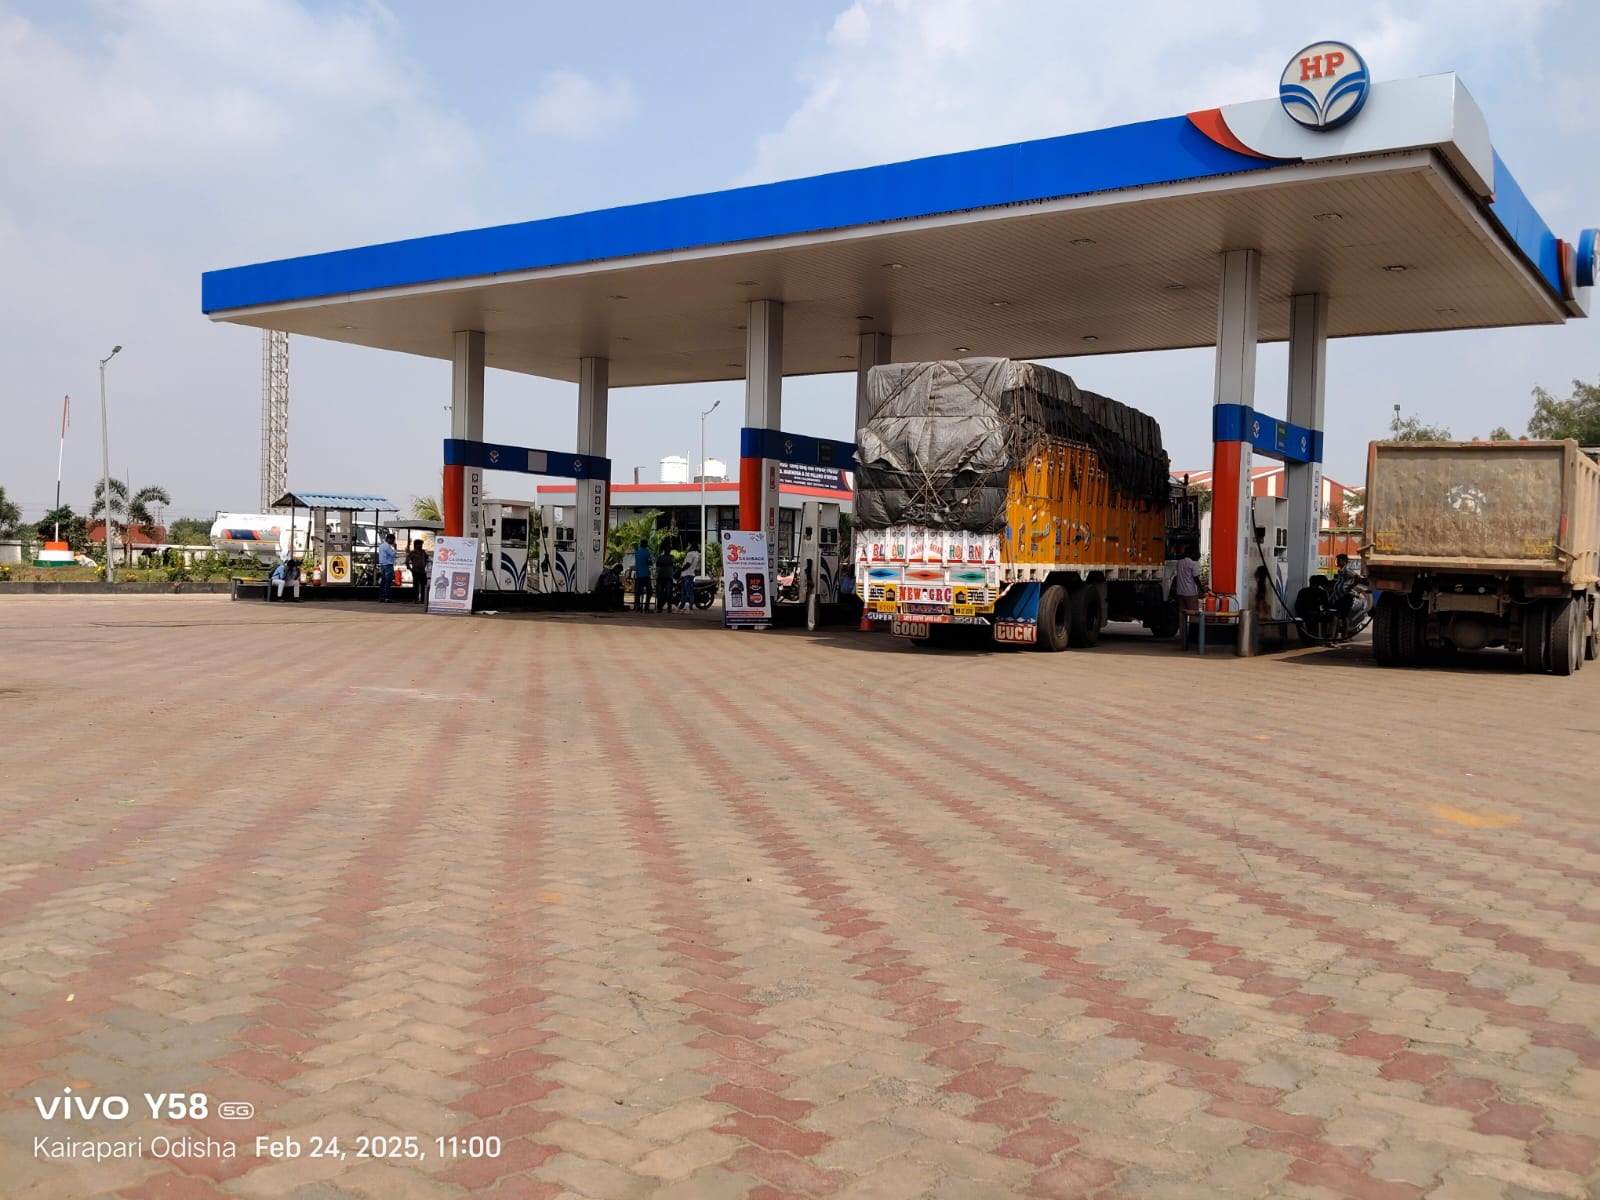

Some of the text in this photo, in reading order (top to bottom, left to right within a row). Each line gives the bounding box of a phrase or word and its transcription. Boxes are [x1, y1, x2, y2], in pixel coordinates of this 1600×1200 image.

[1300, 52, 1345, 81] HP
[899, 586, 920, 602] NEW
[929, 587, 952, 603] GRC
[878, 604, 895, 612] STOP
[893, 621, 1032, 641] GOOD LUCK
